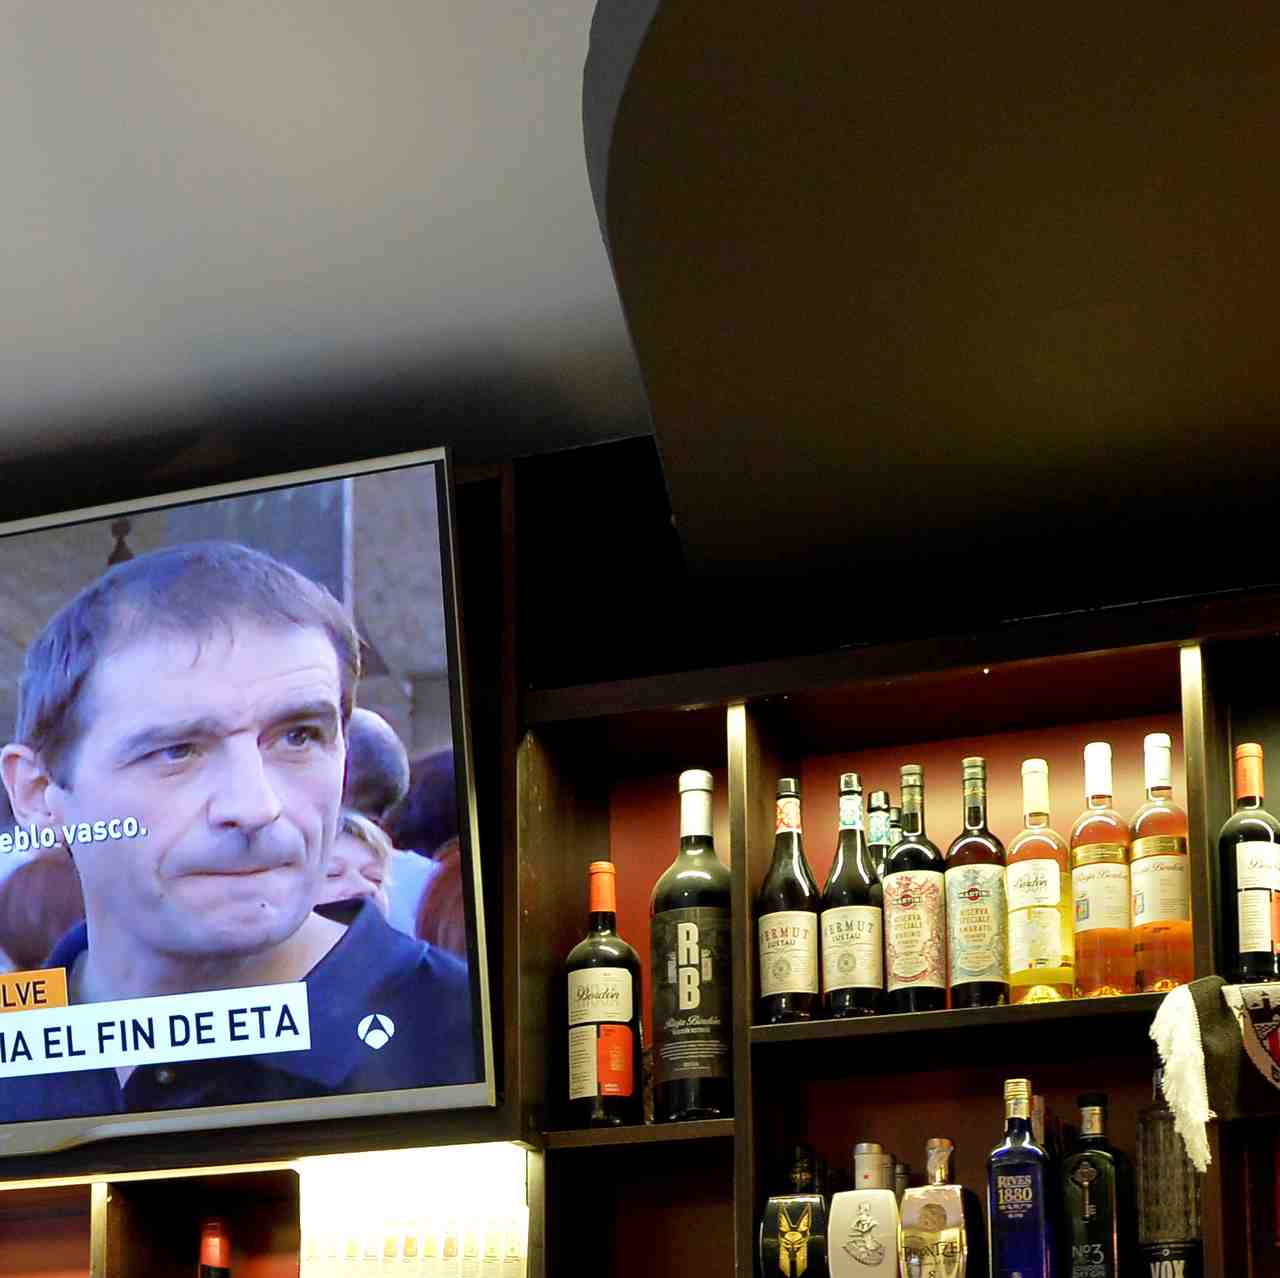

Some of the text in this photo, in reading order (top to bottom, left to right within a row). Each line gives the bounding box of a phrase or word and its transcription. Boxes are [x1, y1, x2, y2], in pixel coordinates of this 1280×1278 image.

[61, 815, 147, 844] vasco.
[44, 1025, 86, 1059] EL
[97, 1017, 155, 1054] FIN
[170, 1011, 215, 1047] DE
[228, 1004, 300, 1041] ETA
[997, 1174, 1033, 1188] RIVES
[997, 1187, 1033, 1203] 1880
